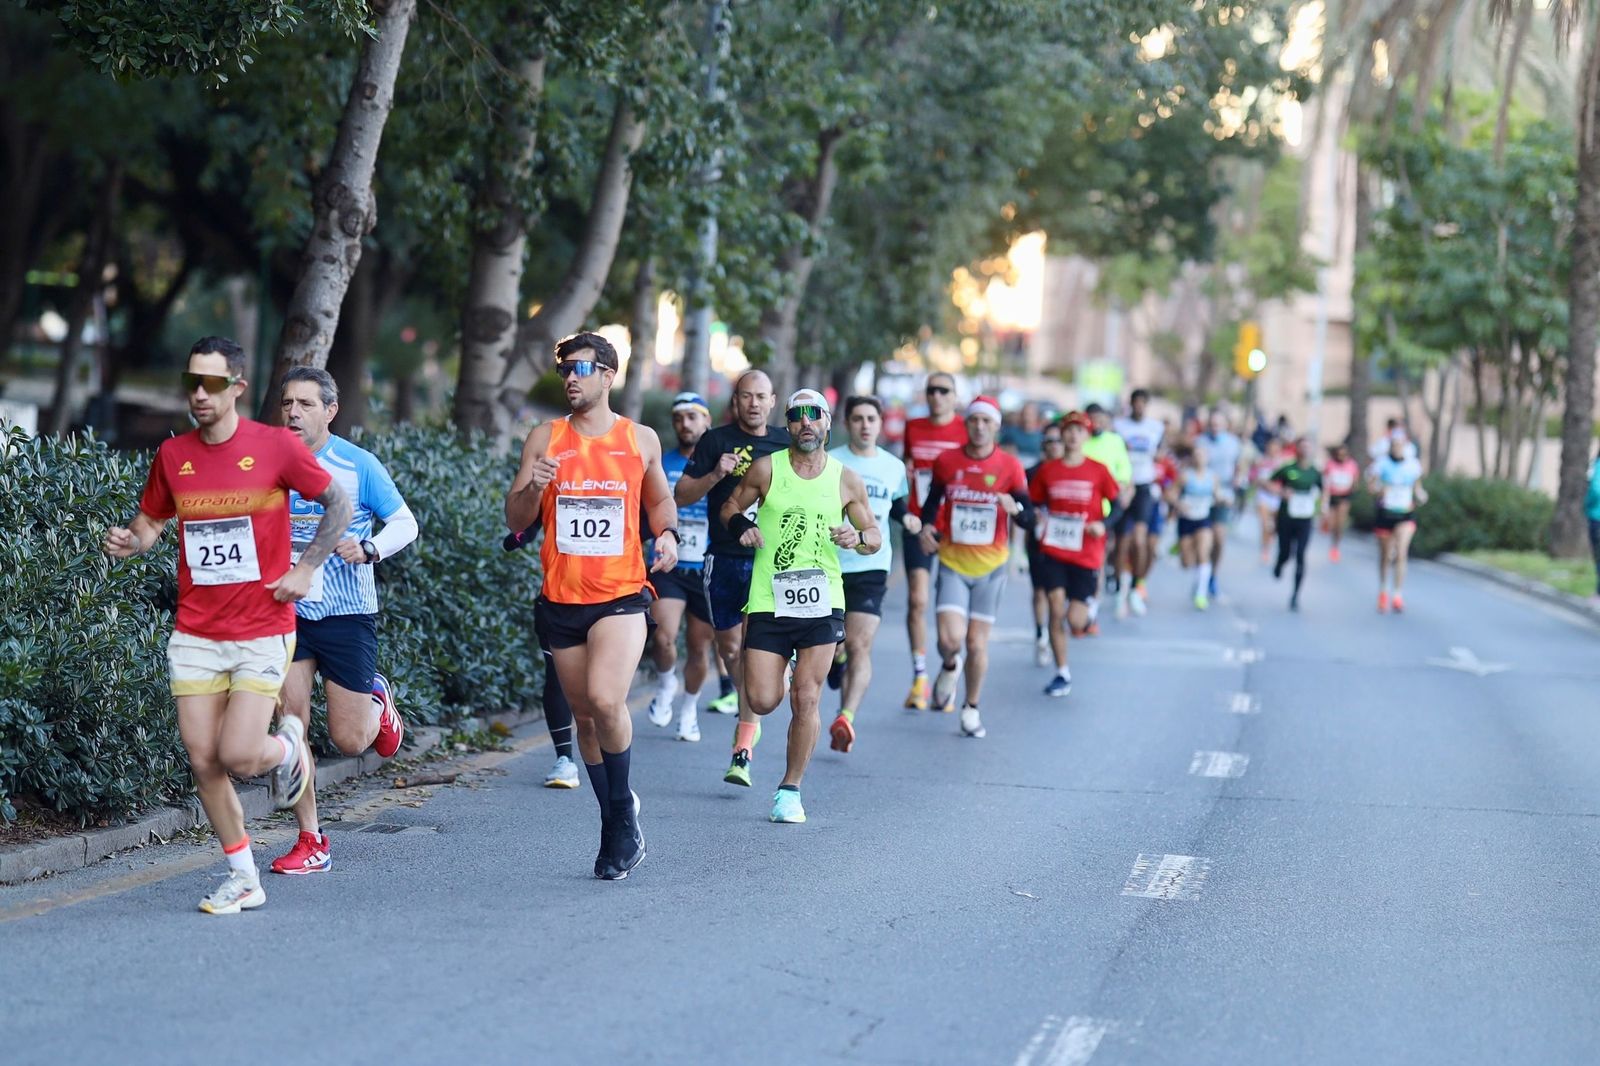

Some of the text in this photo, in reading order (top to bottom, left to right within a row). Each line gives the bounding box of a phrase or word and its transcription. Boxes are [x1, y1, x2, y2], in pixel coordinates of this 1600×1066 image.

[570, 519, 611, 538] 102
[199, 543, 242, 567] 254
[784, 586, 820, 605] 960
